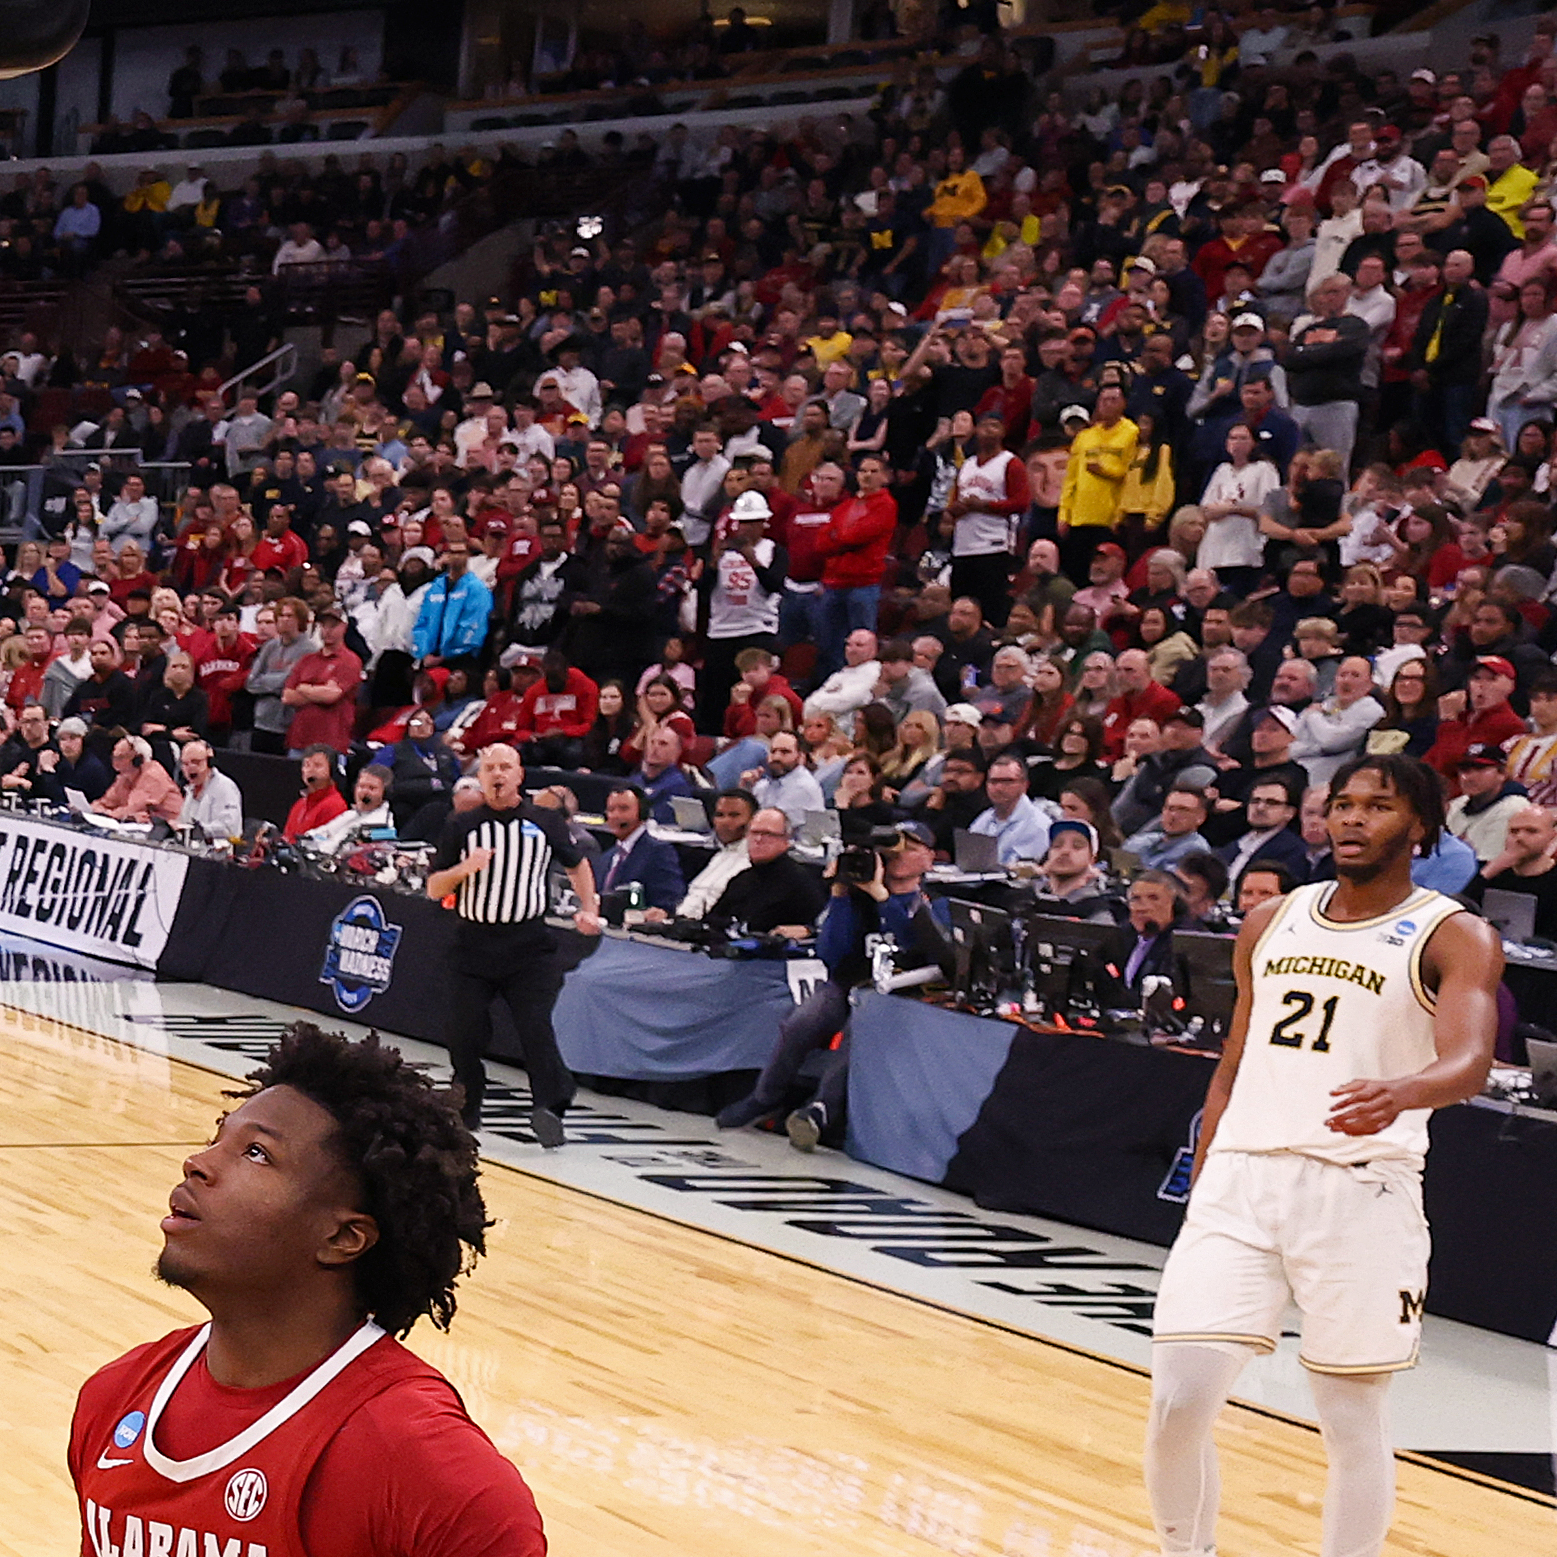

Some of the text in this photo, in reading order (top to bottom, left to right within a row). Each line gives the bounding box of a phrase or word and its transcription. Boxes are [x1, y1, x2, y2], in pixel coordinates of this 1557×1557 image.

[0, 835, 154, 948] REGIONAL
[1263, 956, 1386, 996] MICHIGAN
[1269, 989, 1340, 1053] 21
[228, 1470, 265, 1519] SEC
